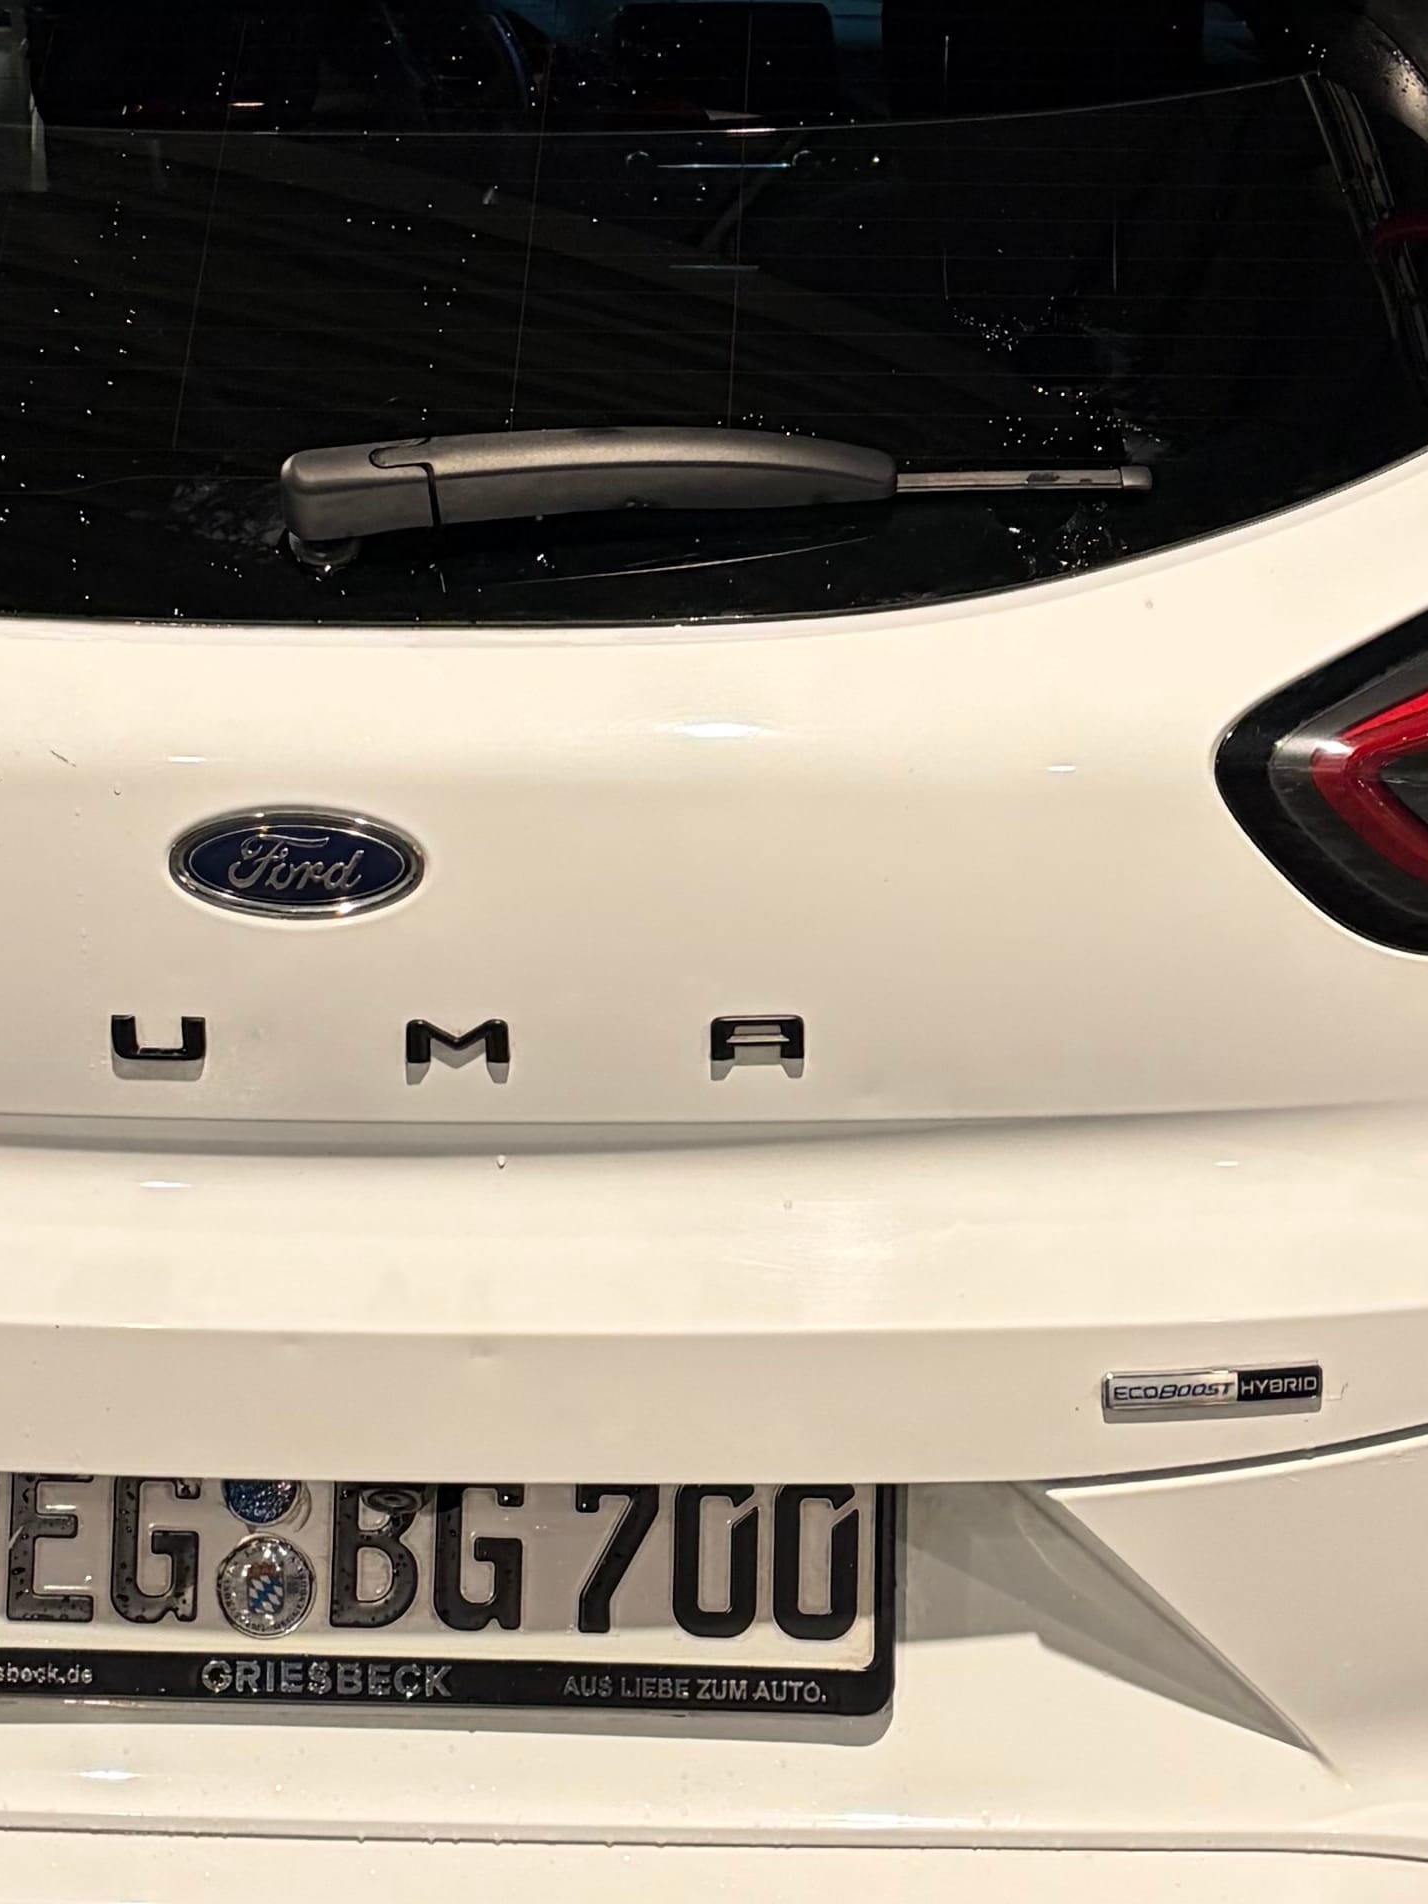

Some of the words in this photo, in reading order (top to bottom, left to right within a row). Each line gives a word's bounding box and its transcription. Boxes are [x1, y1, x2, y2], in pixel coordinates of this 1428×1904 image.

[227, 833, 365, 890] Ford
[1240, 1375, 1318, 1396] HYBRID
[328, 1482, 525, 1631] BG
[574, 1482, 861, 1641] 700
[201, 1659, 452, 1698] GRIESBECK
[563, 1675, 613, 1697] AUS
[621, 1676, 690, 1699] LIEBE
[696, 1679, 748, 1701] ZUM
[752, 1680, 827, 1703] AUTO.
